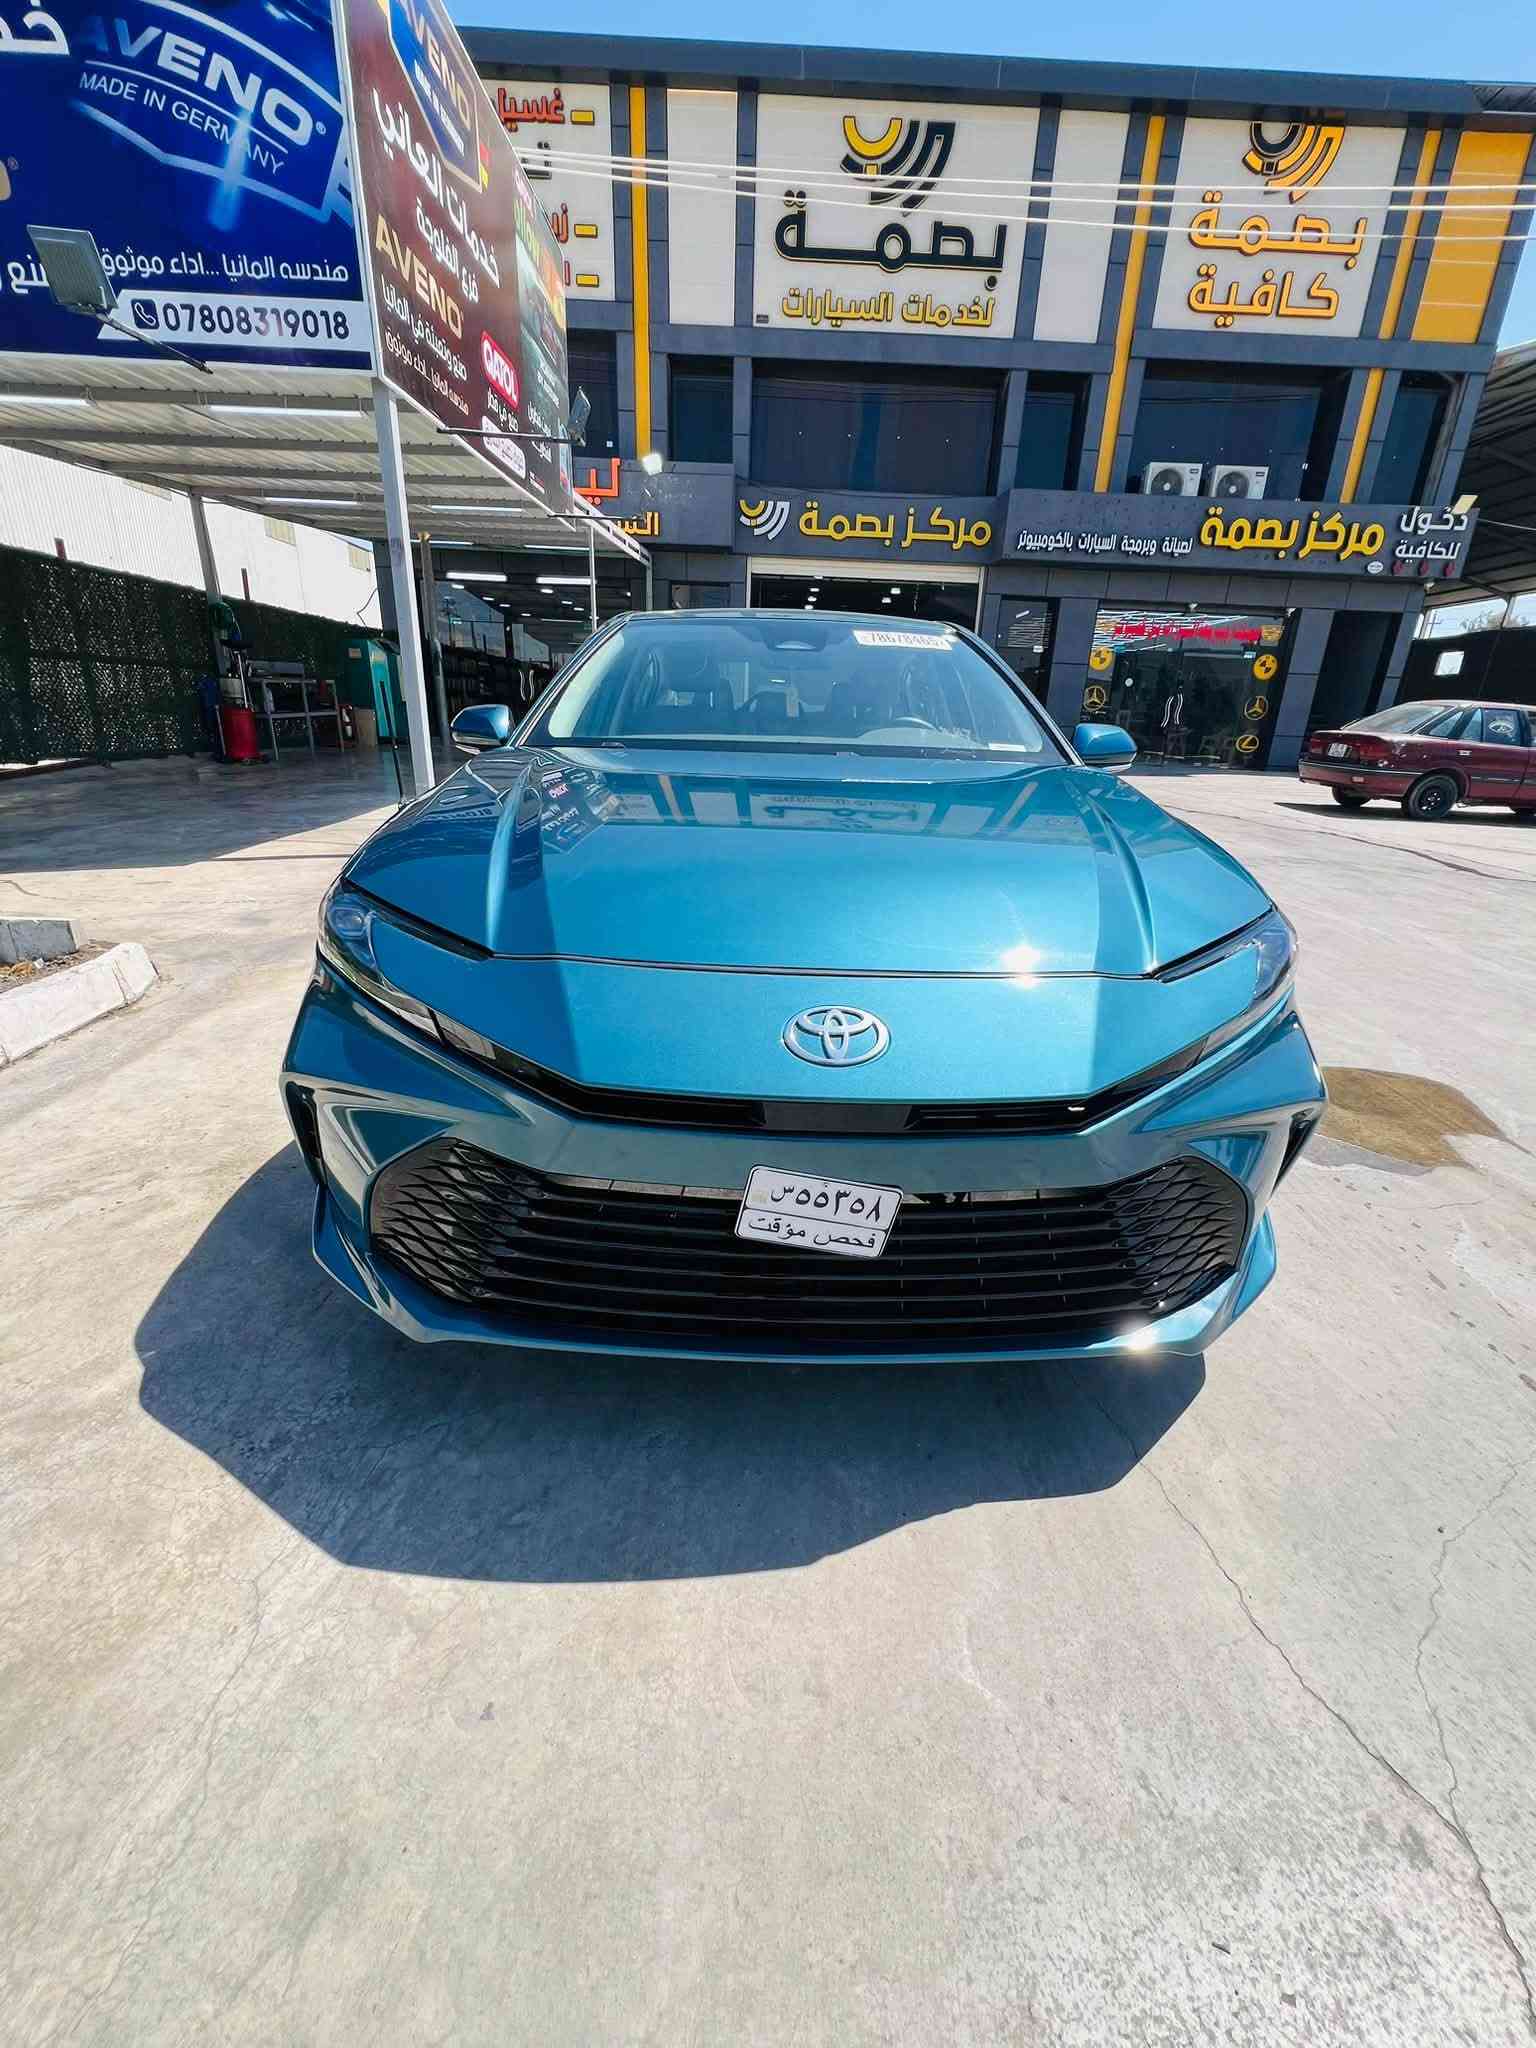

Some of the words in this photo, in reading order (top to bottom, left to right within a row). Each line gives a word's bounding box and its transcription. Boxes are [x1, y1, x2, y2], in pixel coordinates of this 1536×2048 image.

[79, 71, 139, 101] MADE
[143, 88, 166, 112] IN
[446, 184, 500, 289] خدمات
[775, 190, 1008, 291] بصمة
[1188, 190, 1369, 271] بصمة
[8, 254, 49, 294] نع
[101, 246, 164, 279] موثوق
[375, 214, 463, 340] AVENO
[781, 287, 895, 328] السيارات
[901, 293, 996, 327] لخدمات
[1188, 263, 1340, 328] كافية
[162, 302, 350, 340] 07808319018
[483, 339, 518, 403] QATOL
[799, 500, 895, 546] بصمة
[900, 506, 993, 550] مركز
[1200, 506, 1300, 560] بصمة
[1298, 510, 1386, 561] مركز
[1400, 505, 1468, 535] دخول
[1078, 532, 1117, 553] السيارات
[1121, 535, 1157, 556] وبرمجة
[1162, 536, 1193, 557] لصيانة
[1395, 539, 1462, 563] للكافية
[749, 1217, 806, 1240] مؤقت
[813, 1231, 876, 1249] فحص
